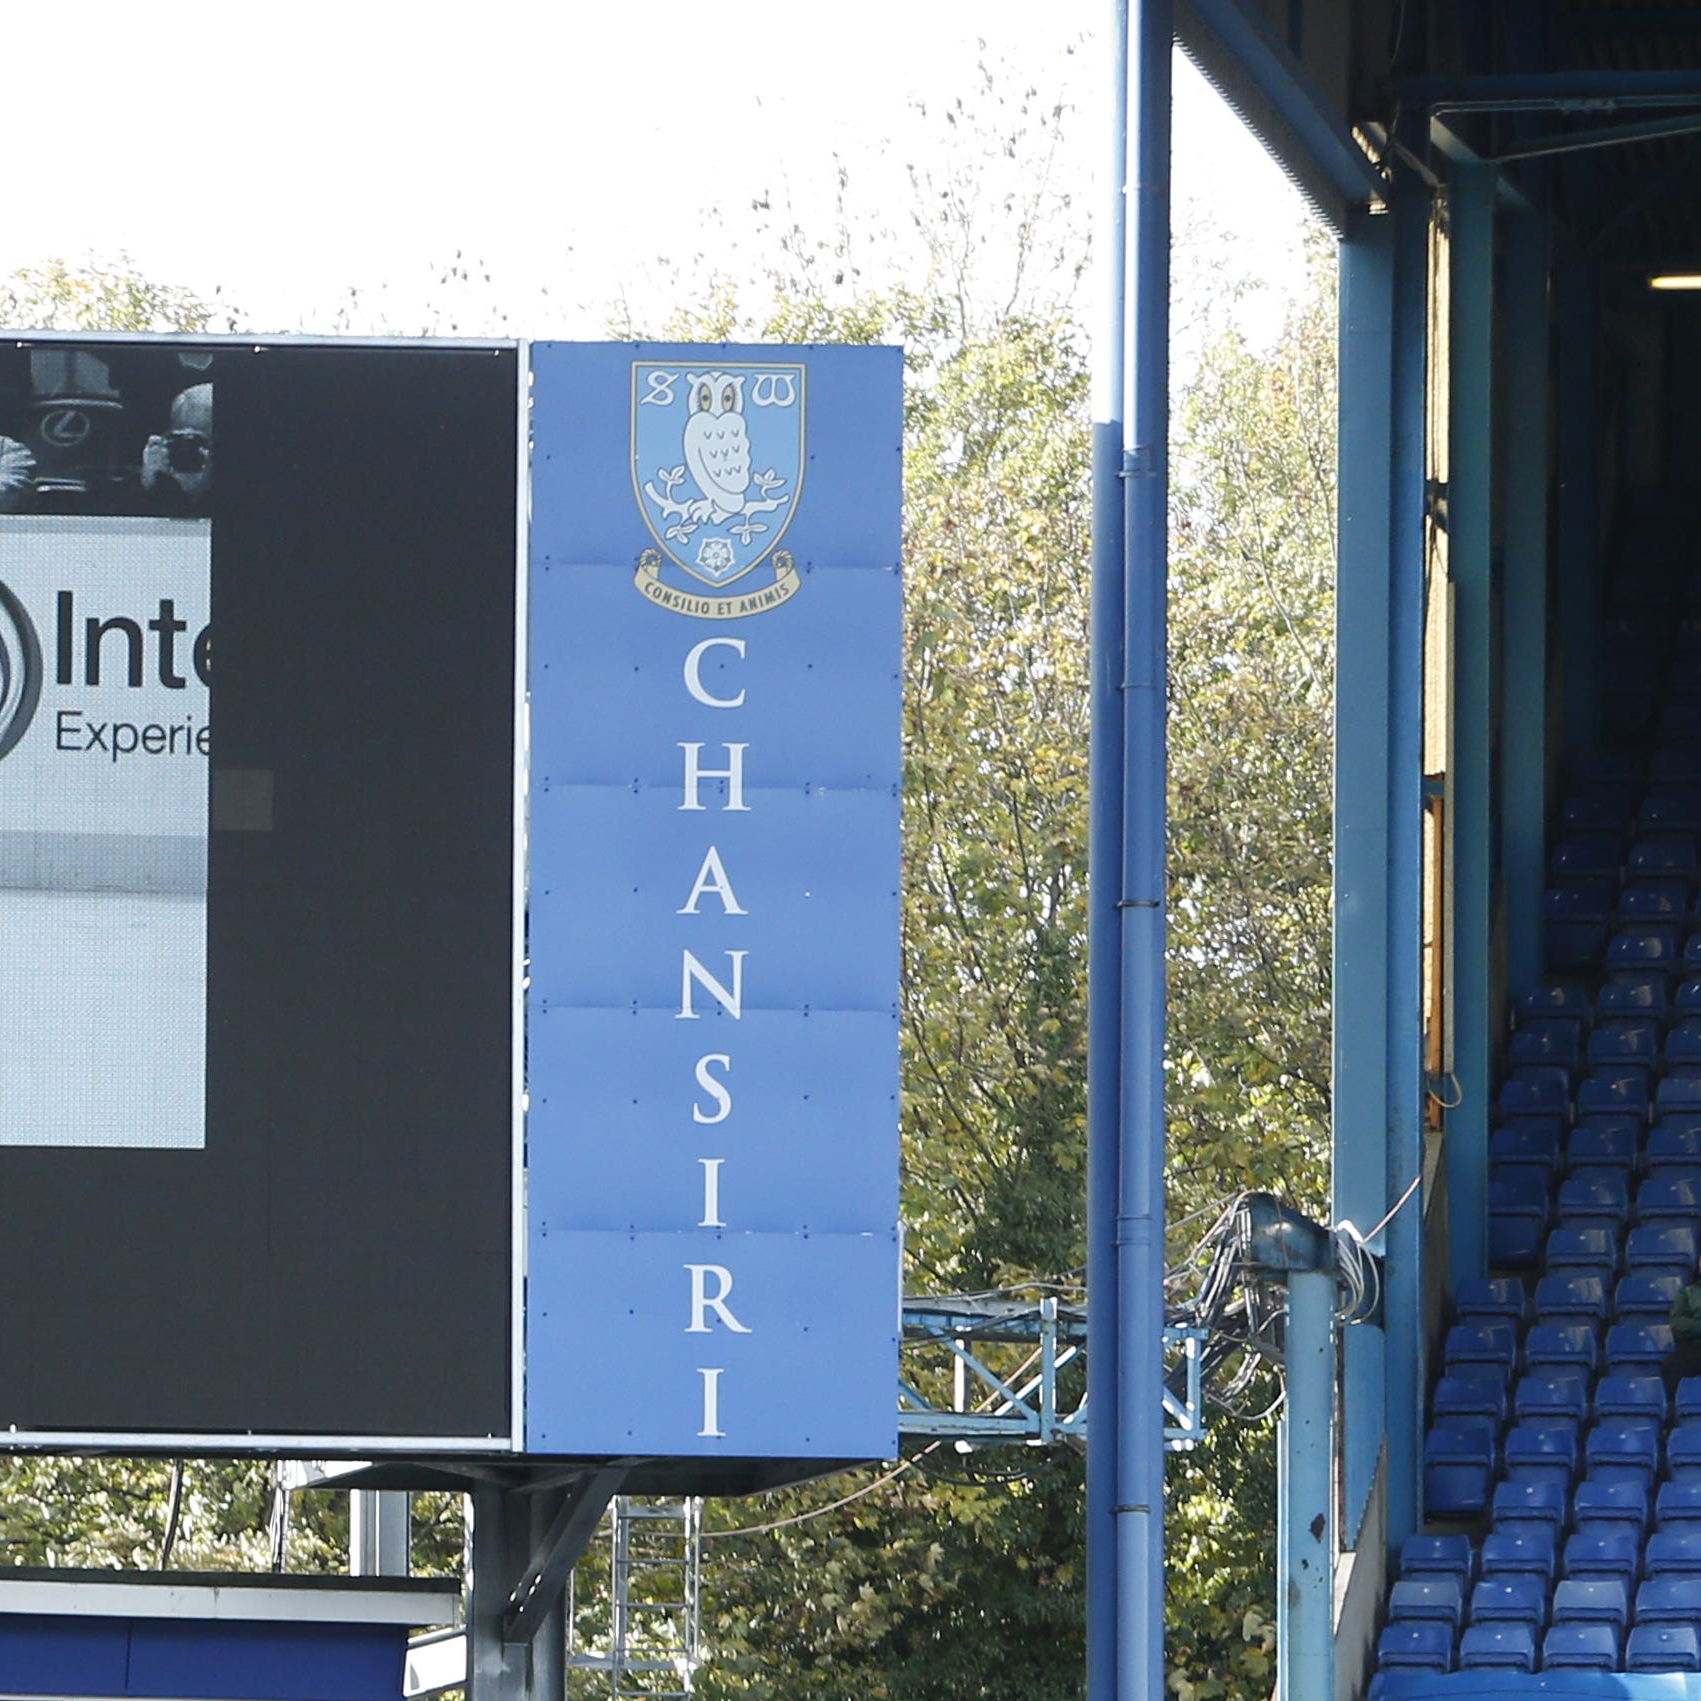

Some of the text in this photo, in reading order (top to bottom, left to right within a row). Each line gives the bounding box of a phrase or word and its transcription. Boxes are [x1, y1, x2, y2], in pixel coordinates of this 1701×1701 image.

[644, 580, 790, 616] CONSILIO ET ANIMIS
[674, 637, 753, 1438] CHANSIRI
